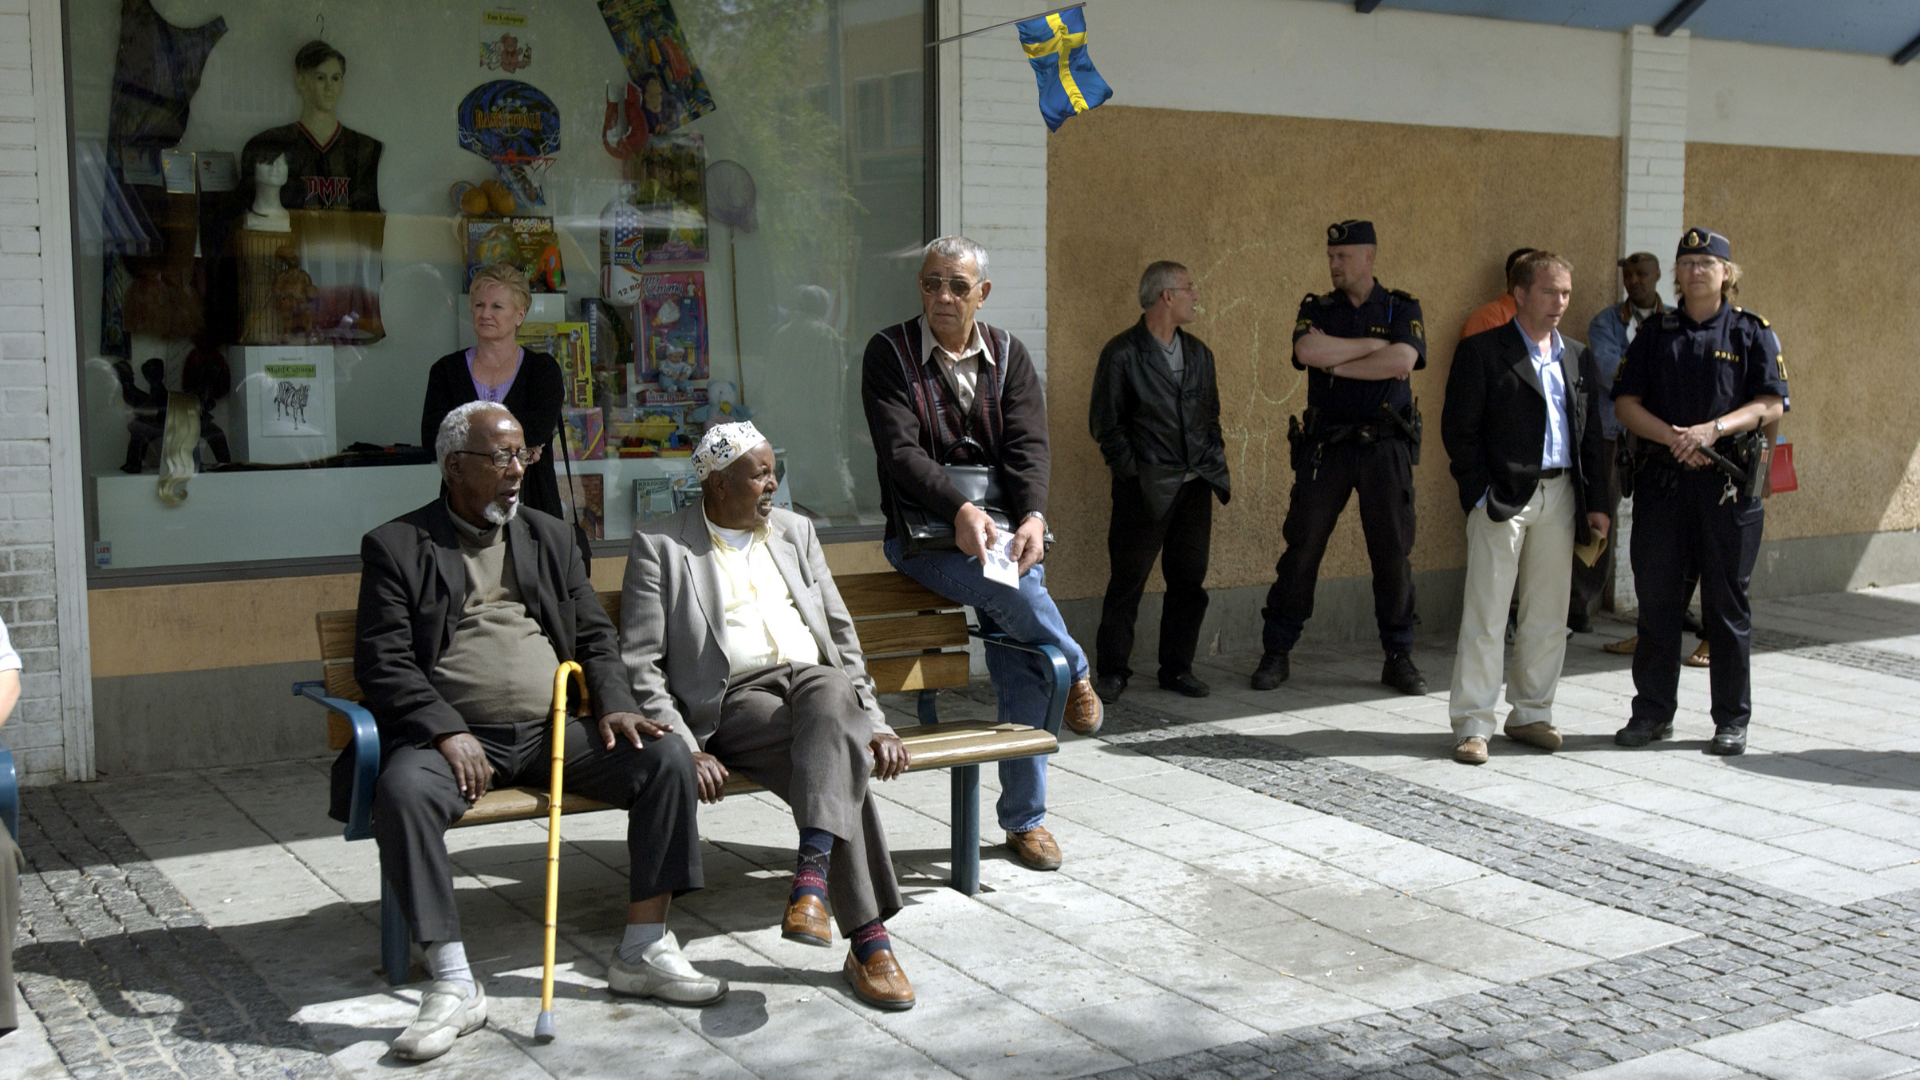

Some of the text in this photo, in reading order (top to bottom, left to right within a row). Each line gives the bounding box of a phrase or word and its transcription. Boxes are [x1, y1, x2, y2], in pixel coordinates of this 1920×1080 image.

[475, 109, 543, 131] BASKETBALL
[301, 176, 351, 206] DMX
[617, 288, 629, 297] 12
[1713, 350, 1740, 363] POLIS
